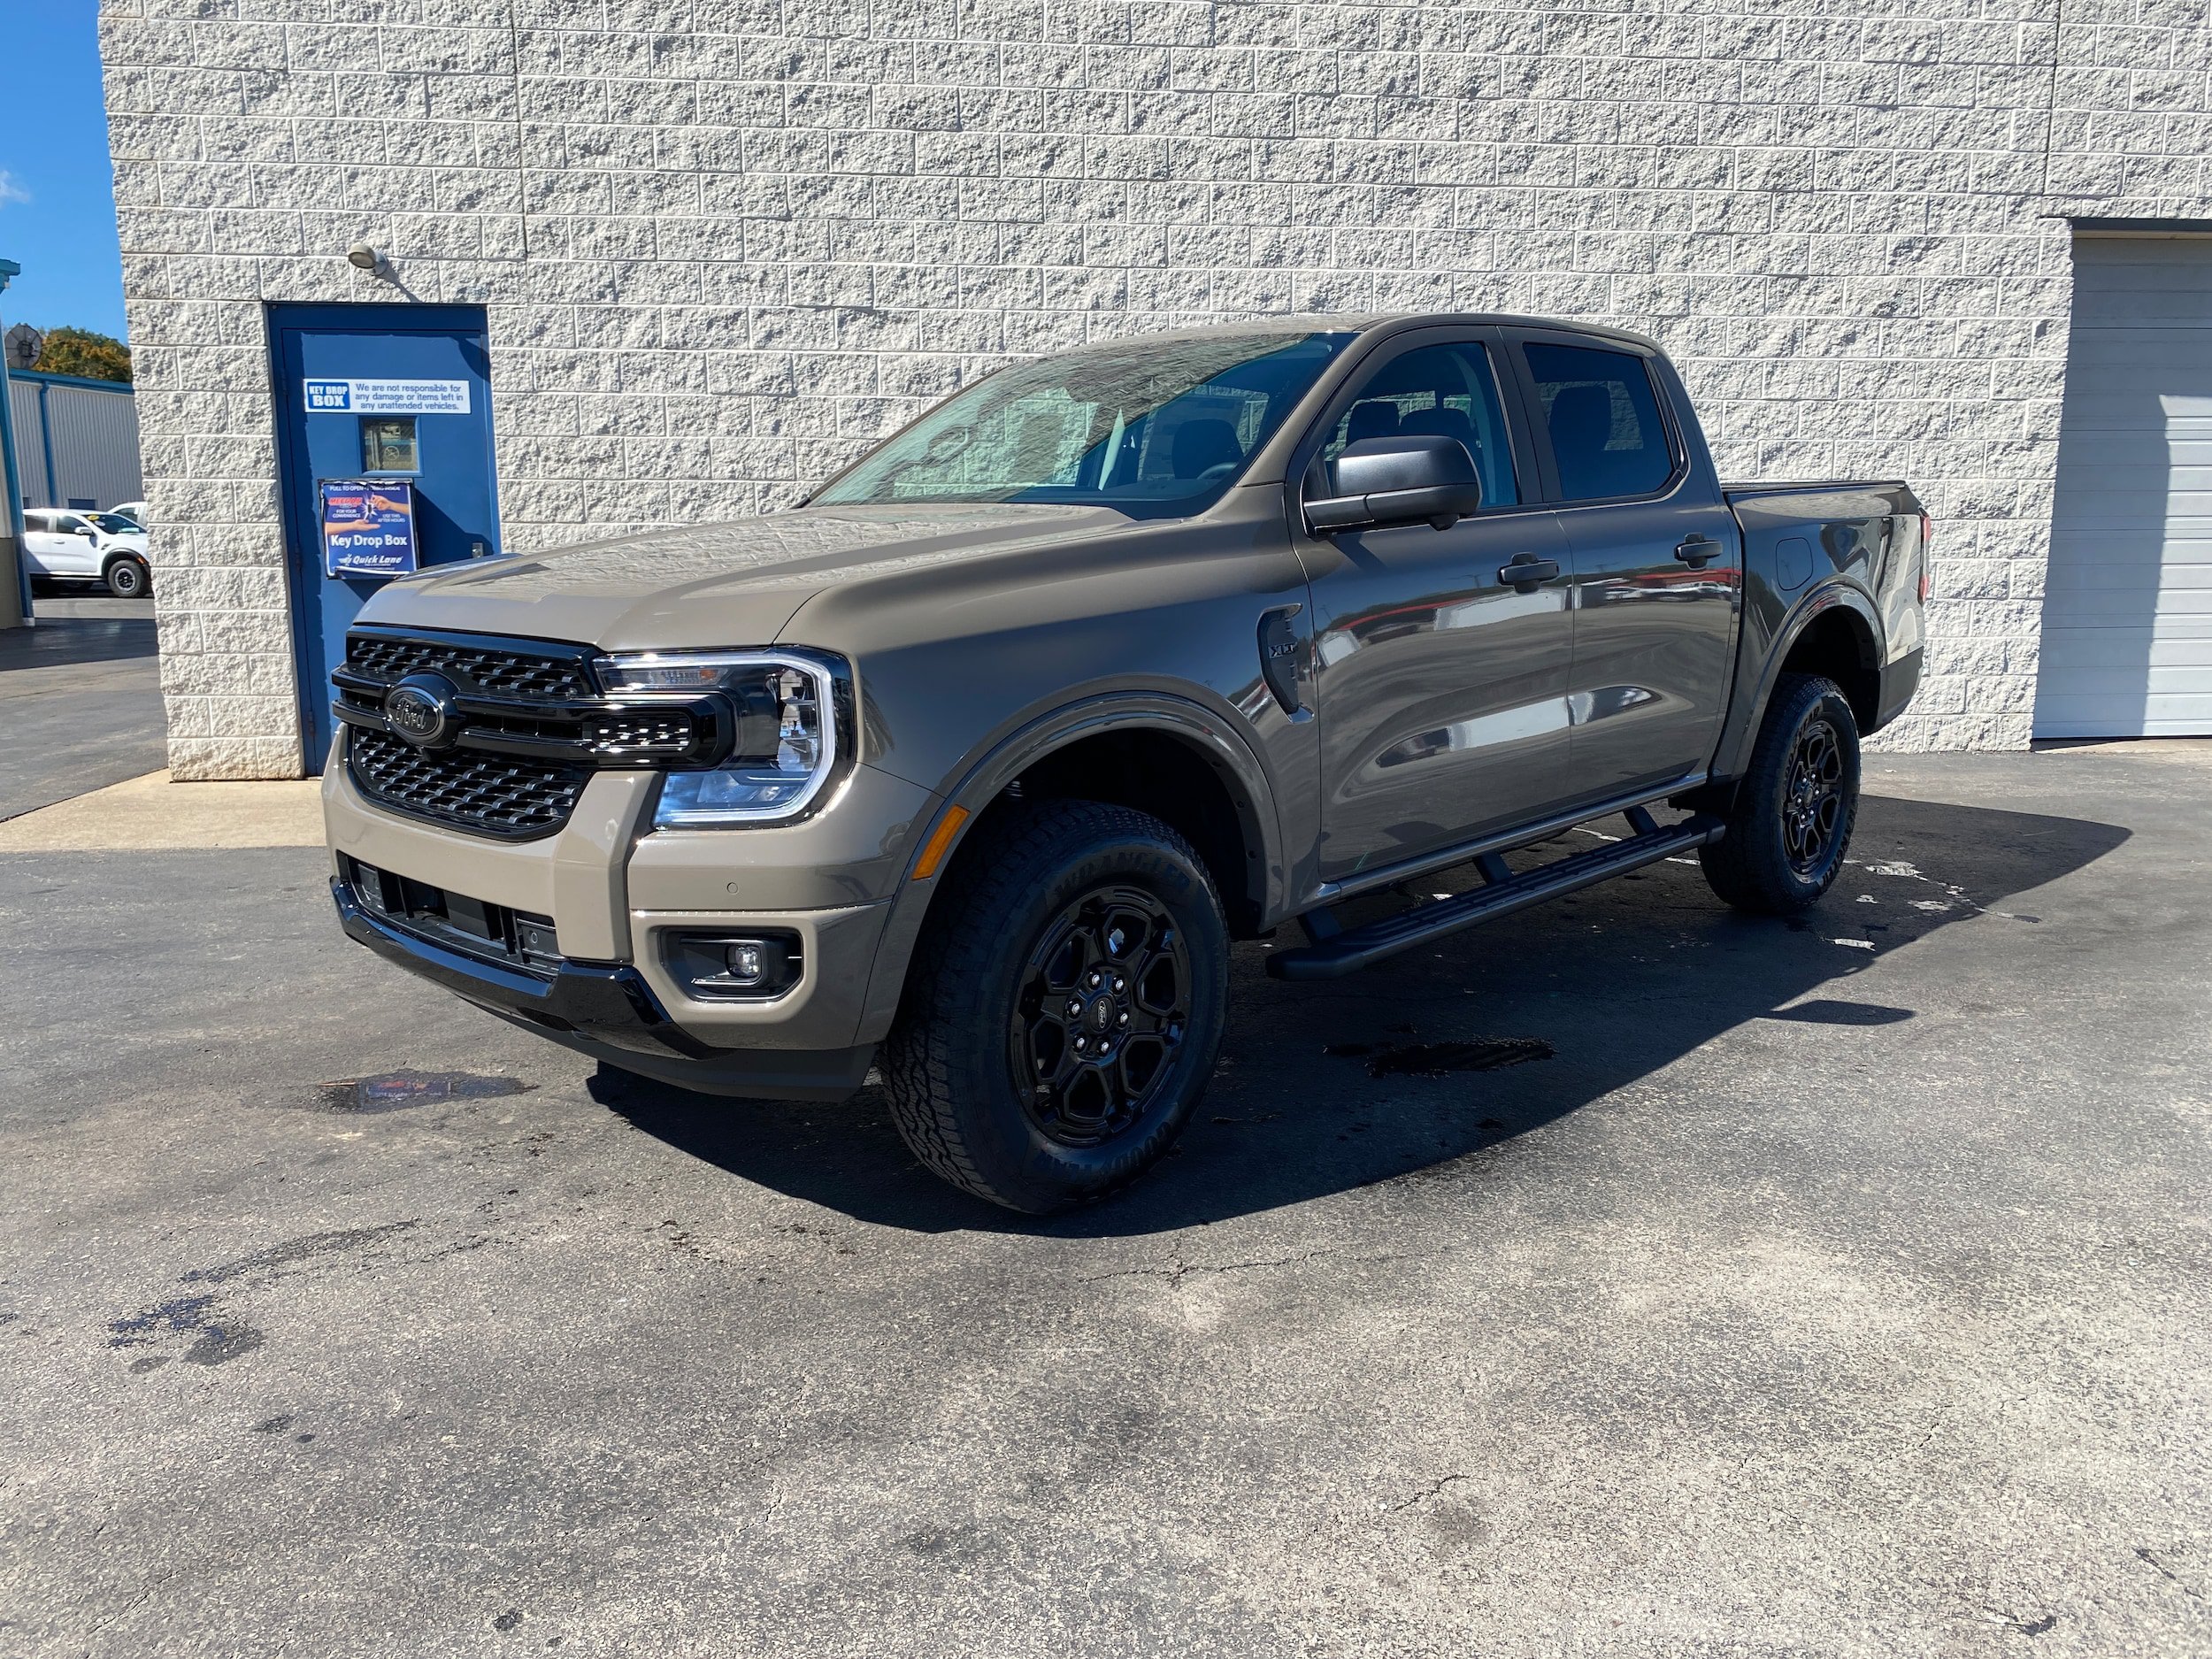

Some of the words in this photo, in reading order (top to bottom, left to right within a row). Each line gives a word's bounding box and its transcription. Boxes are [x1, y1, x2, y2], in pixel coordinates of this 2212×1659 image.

[309, 386, 324, 396] KEY
[326, 386, 348, 396] DROP
[356, 383, 370, 392] We
[402, 384, 449, 394] responsible
[312, 396, 345, 407] BOX
[356, 394, 370, 403] any
[373, 393, 404, 403] damage
[417, 393, 439, 402] items
[441, 393, 454, 402] left
[425, 402, 459, 411] vehicles.
[331, 534, 351, 549] Key
[354, 534, 383, 549] Drop
[384, 534, 407, 546] Box
[353, 555, 379, 565] Quick
[379, 555, 403, 564] Lane
